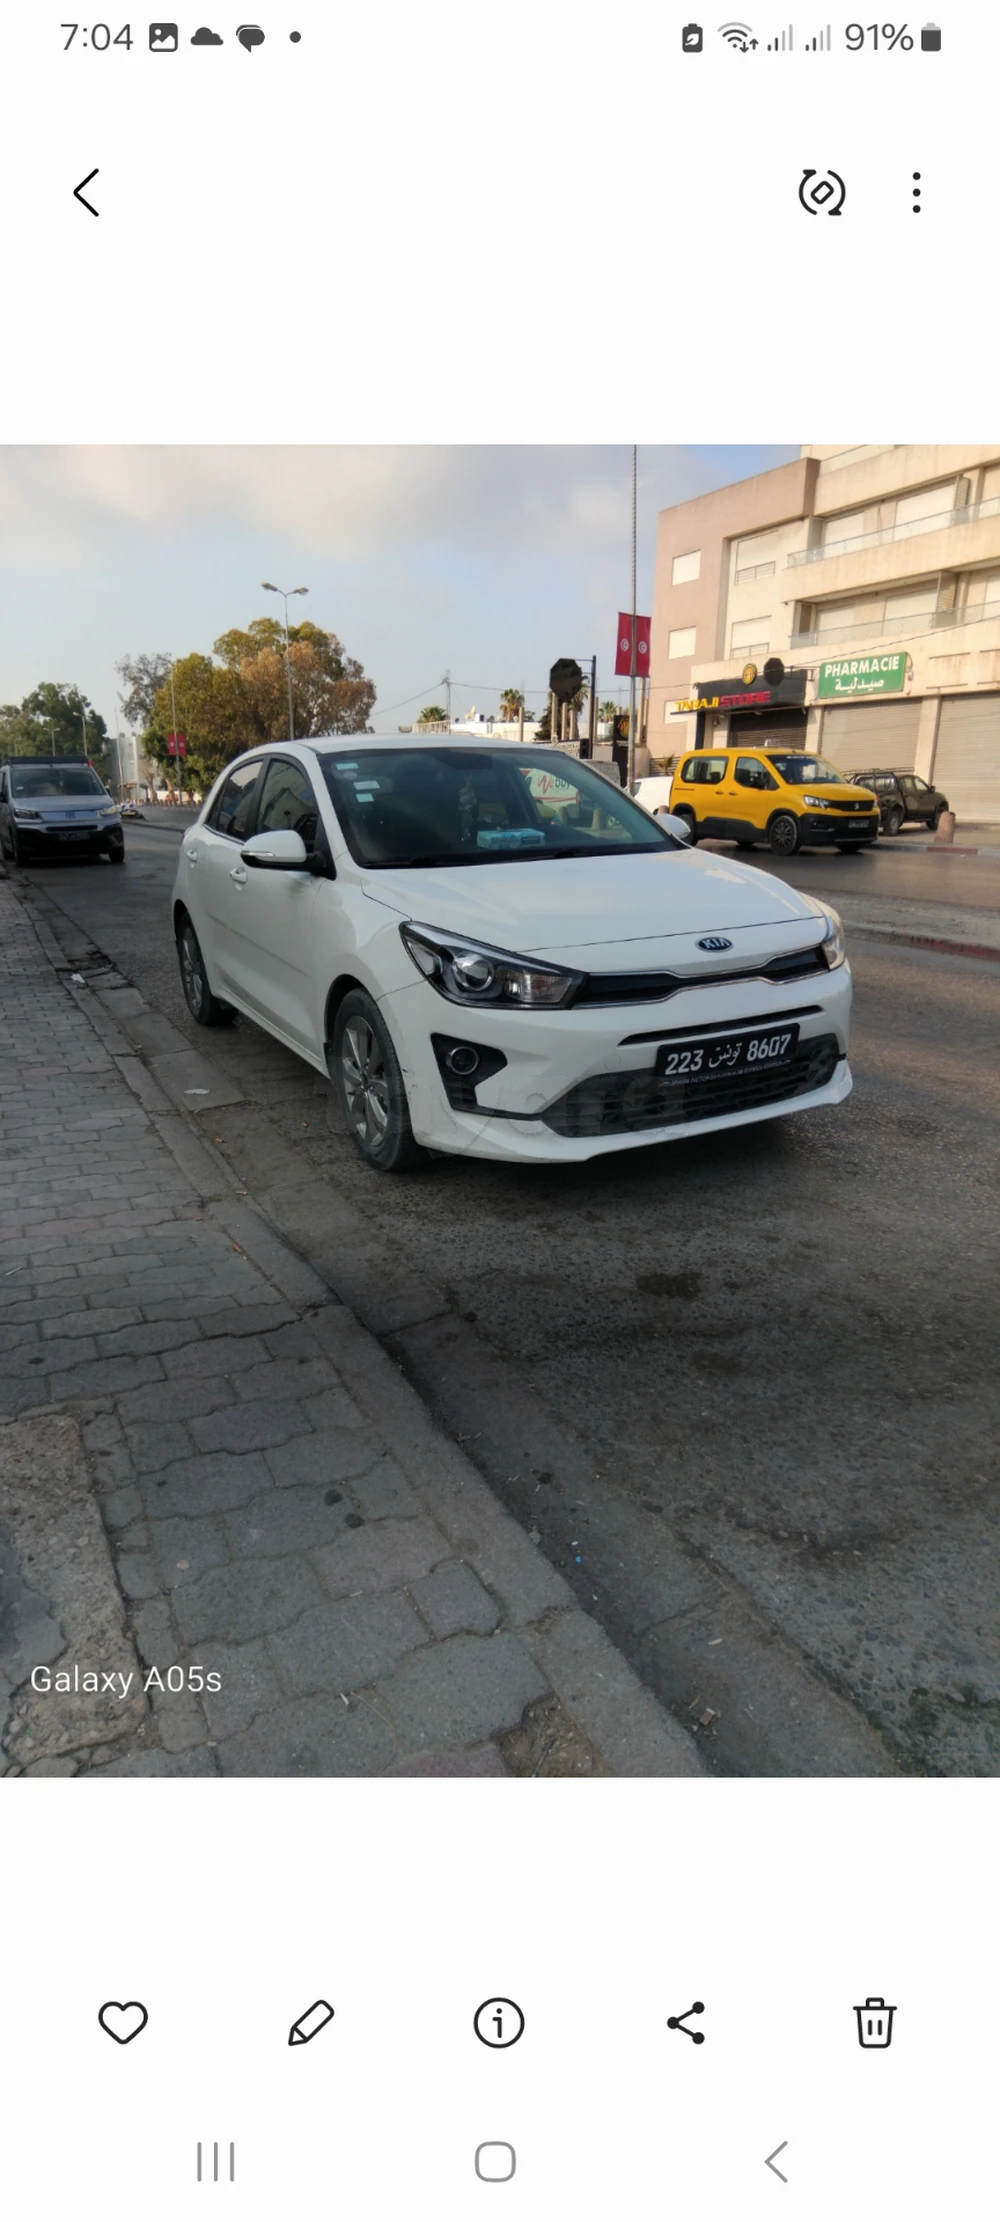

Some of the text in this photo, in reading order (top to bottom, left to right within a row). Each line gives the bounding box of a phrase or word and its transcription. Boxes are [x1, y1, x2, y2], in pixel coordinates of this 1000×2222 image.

[825, 656, 899, 678] PHARMACIE
[834, 676, 885, 693] صيدلية
[675, 690, 771, 712] TARAJI STORE
[701, 938, 731, 949] KIA
[665, 1049, 704, 1075] 223
[708, 1042, 743, 1068] تونس
[746, 1033, 792, 1062] 8607
